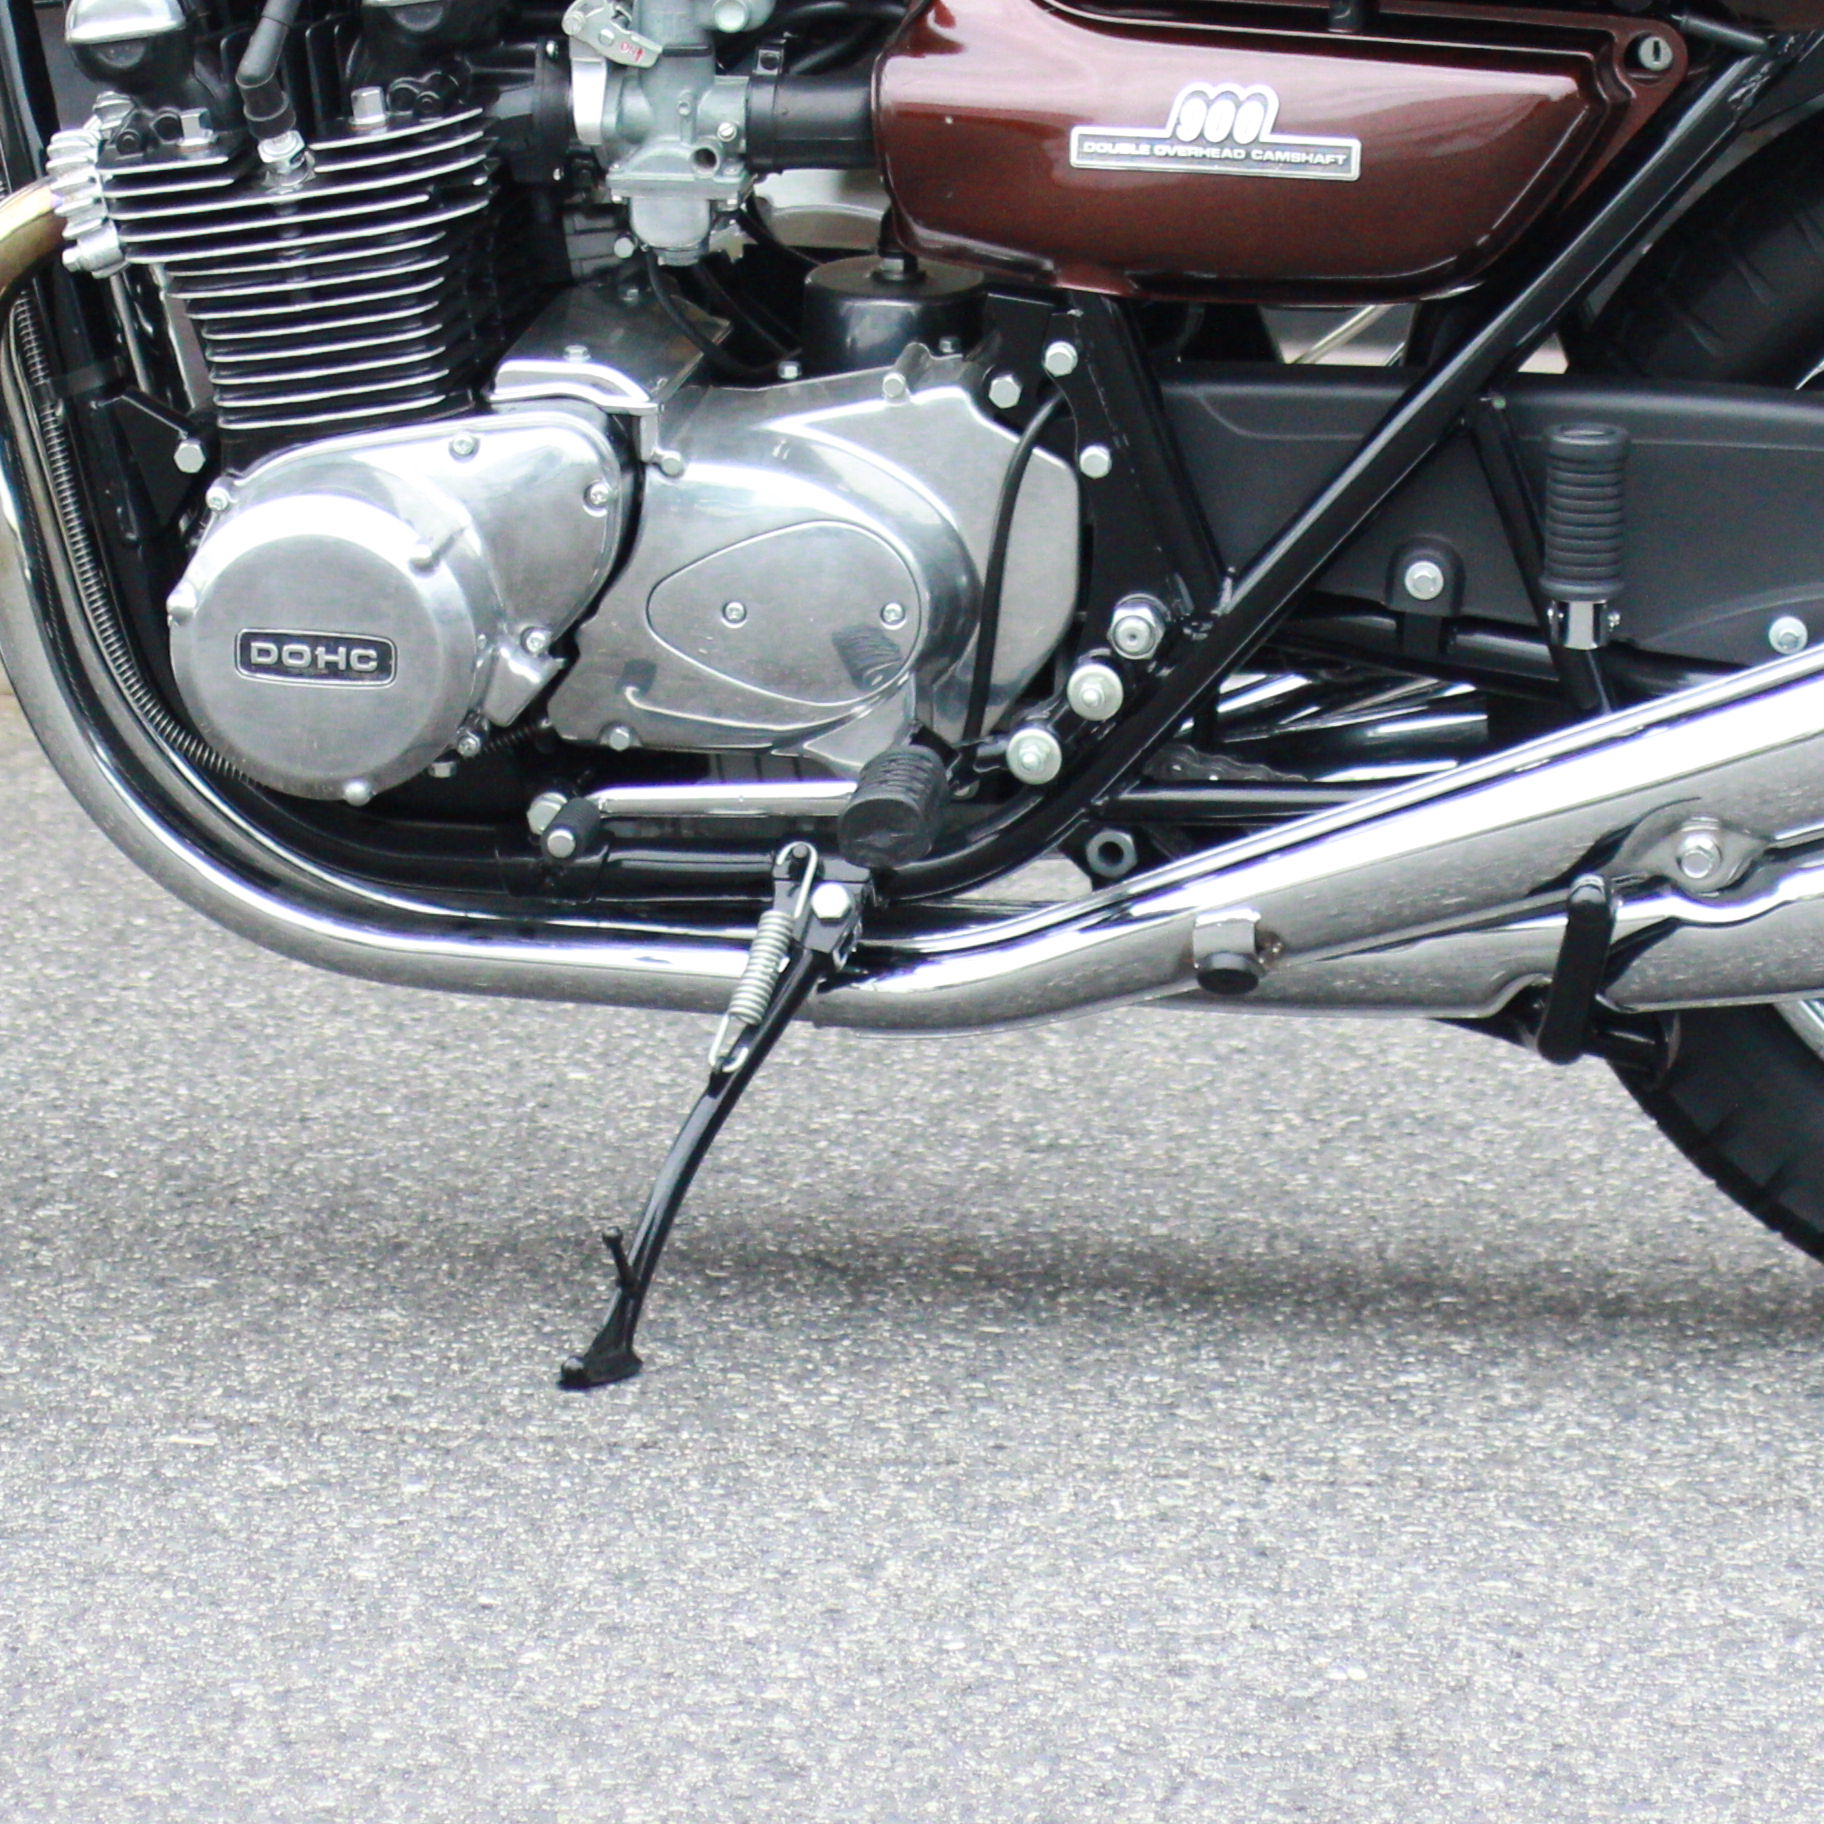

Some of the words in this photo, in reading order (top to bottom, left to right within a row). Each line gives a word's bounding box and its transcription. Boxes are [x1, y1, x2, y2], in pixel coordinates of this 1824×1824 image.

[1177, 97, 1265, 144] 900
[1083, 142, 1150, 155] DOUBLE
[1154, 144, 1246, 160] OVERHEAD
[1251, 149, 1346, 165] CAMSHAFT
[250, 642, 378, 672] DOHC
